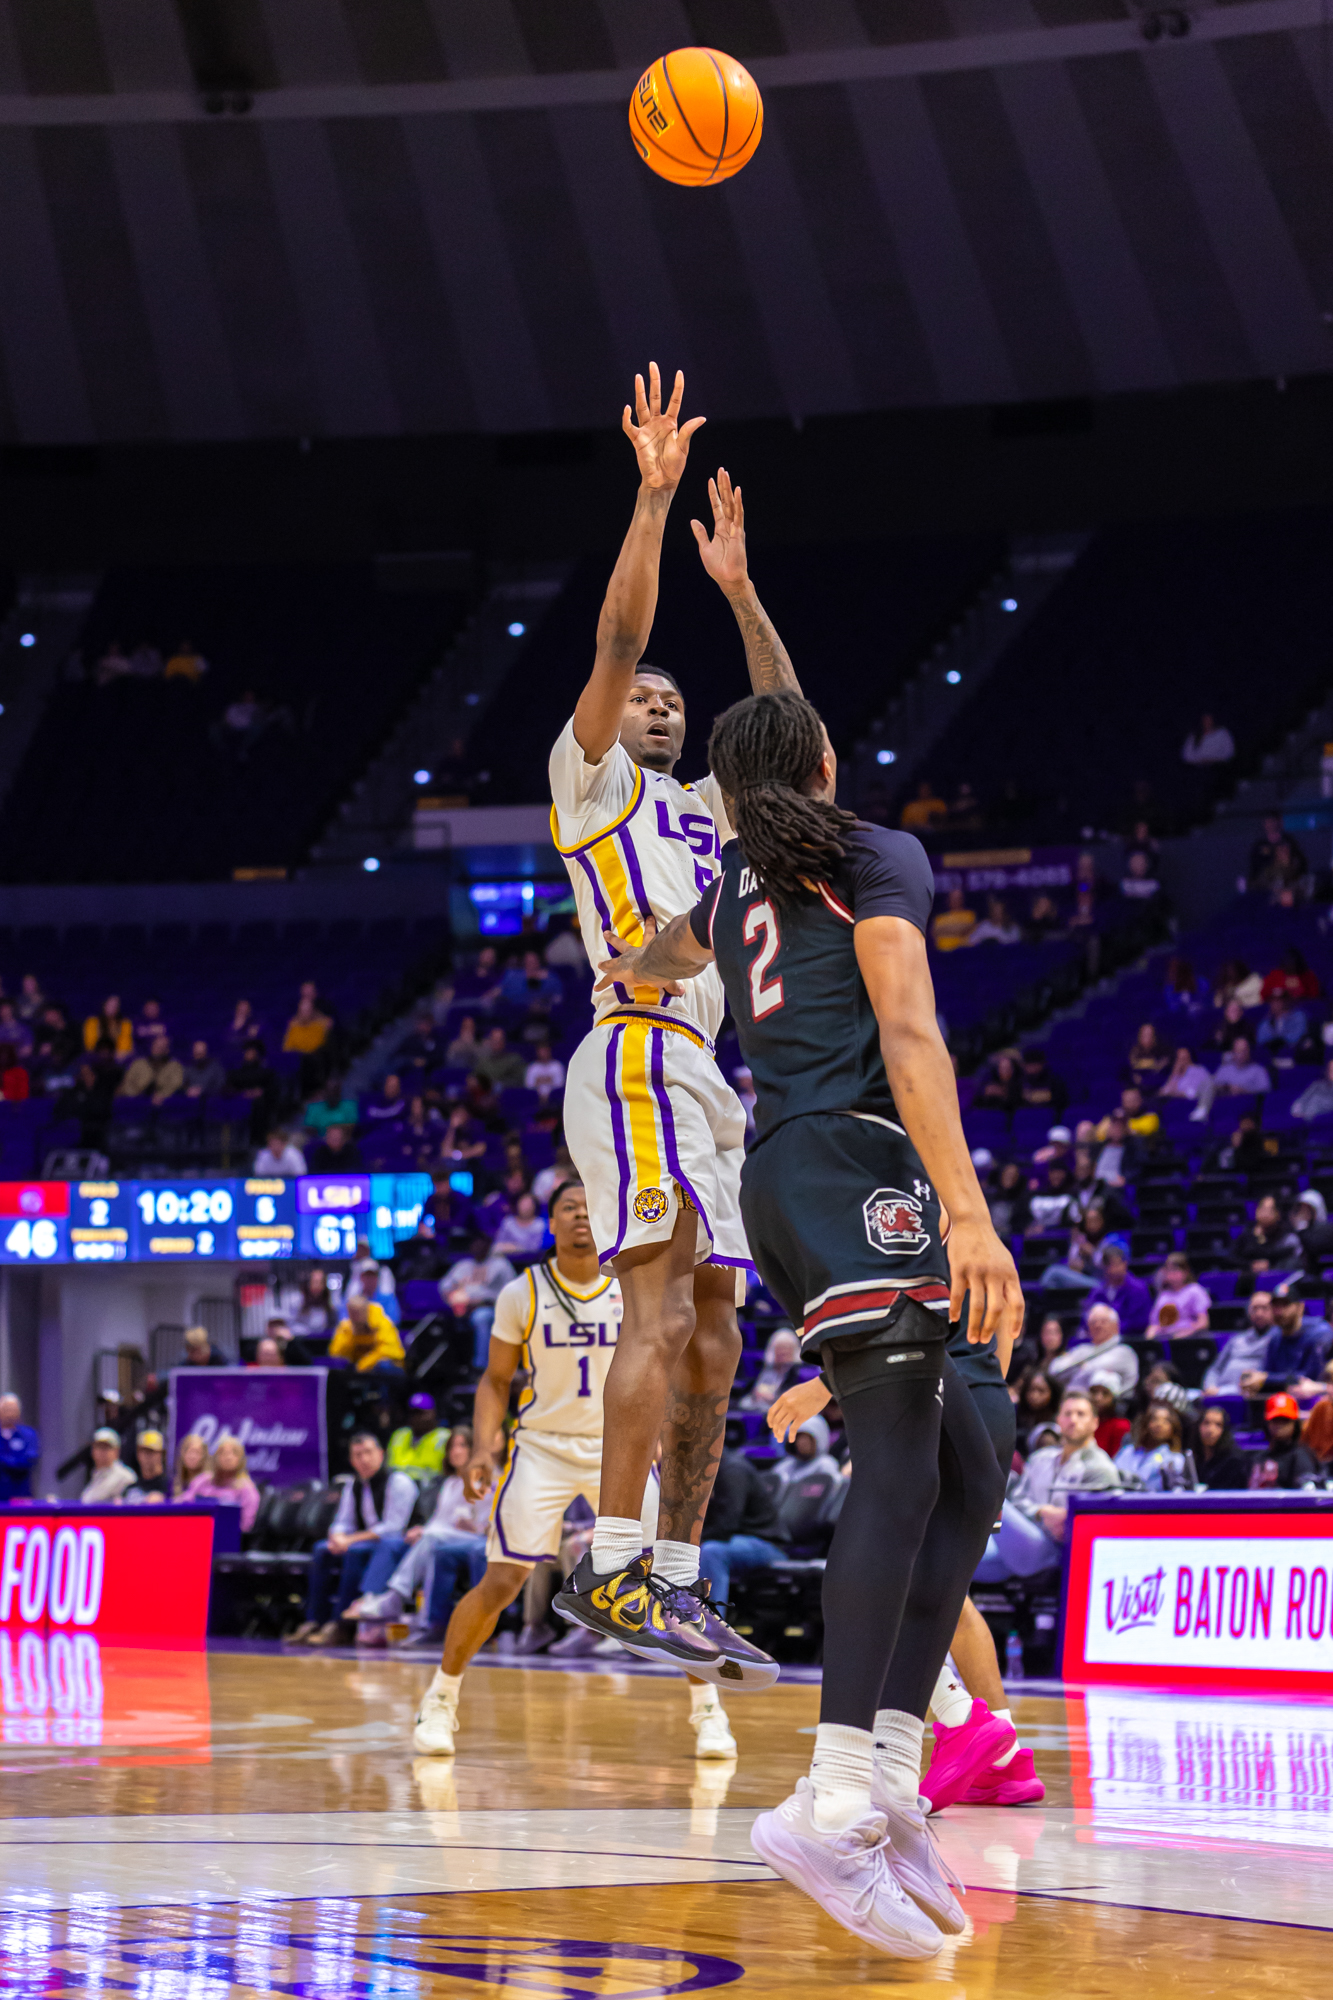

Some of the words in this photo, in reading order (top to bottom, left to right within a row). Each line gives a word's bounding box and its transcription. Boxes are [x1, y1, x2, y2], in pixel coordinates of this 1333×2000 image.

[738, 867, 765, 899] DA
[742, 897, 785, 1024] 2
[137, 1189, 233, 1225] 10:20
[5, 1218, 58, 1260] 46
[196, 1230, 215, 1255] 2
[314, 1214, 358, 1256] 61
[577, 1355, 592, 1398] 1
[0, 1525, 105, 1626] FOOD
[1102, 1565, 1167, 1633] Visit
[1173, 1565, 1275, 1639] BATON
[1286, 1565, 1333, 1640] RO
